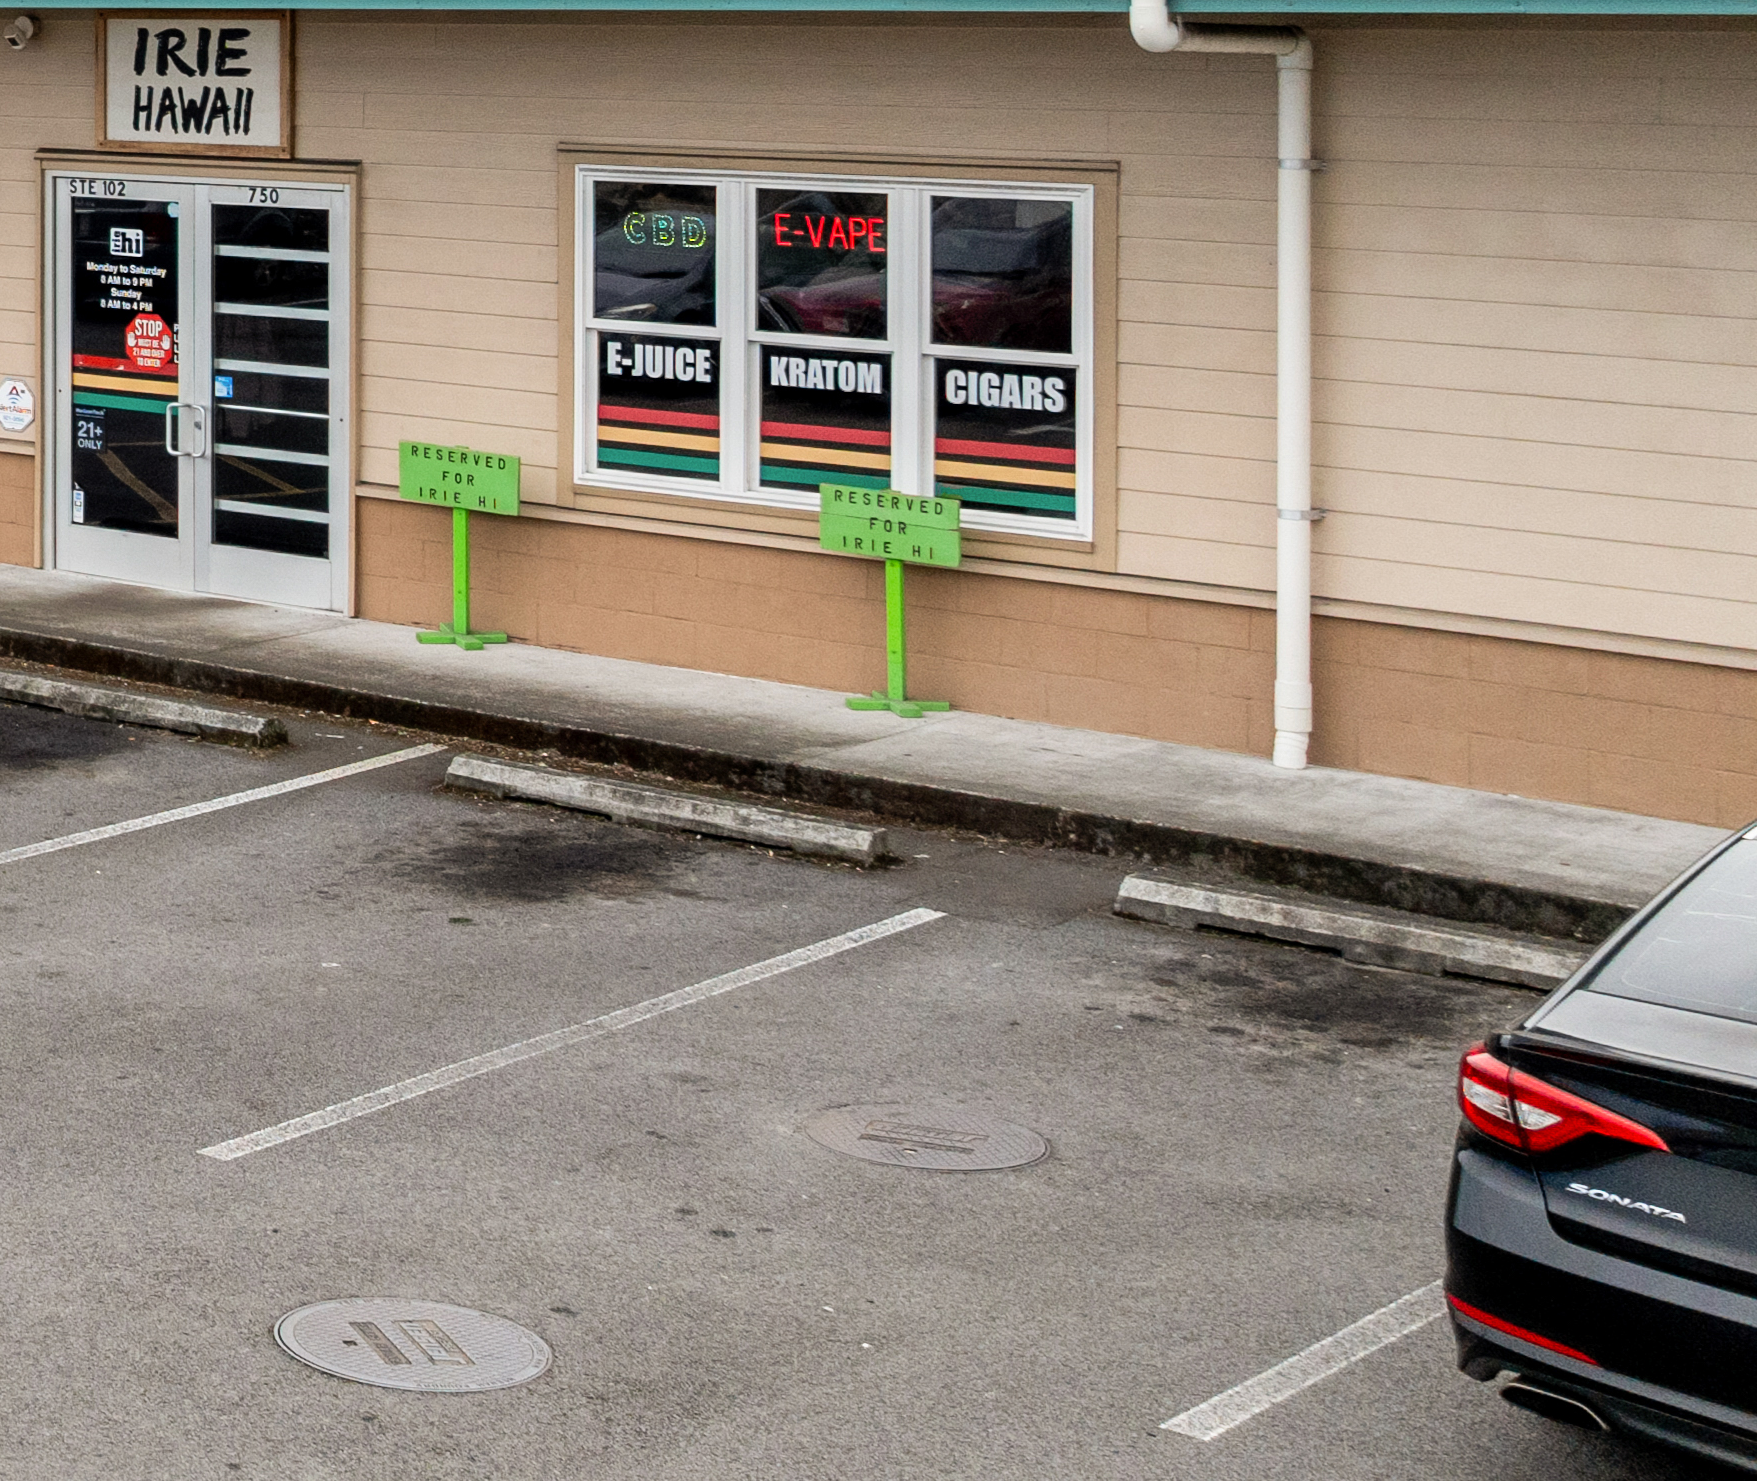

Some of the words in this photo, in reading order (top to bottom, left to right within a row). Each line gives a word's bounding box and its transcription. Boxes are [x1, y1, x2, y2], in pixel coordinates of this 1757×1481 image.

[133, 27, 252, 78] IRIE
[132, 84, 254, 136] HAWAII
[69, 179, 96, 195] STE
[103, 180, 126, 197] 102
[248, 187, 279, 204] 750
[623, 211, 708, 248] CBD
[774, 212, 886, 252] E-VAPE
[121, 231, 141, 255] hi
[86, 261, 118, 275] Monday
[119, 264, 129, 273] to
[129, 264, 167, 279] Saturday
[107, 275, 121, 285] AM
[122, 276, 131, 286] to
[139, 277, 154, 288] PM
[110, 286, 143, 301] Sunday
[107, 299, 121, 309] AM
[122, 301, 131, 310] to
[132, 301, 138, 310] 4
[139, 301, 154, 312] PM
[135, 318, 163, 338] STOP
[133, 347, 140, 356] 21
[152, 339, 160, 348] BE
[137, 357, 144, 366] TO
[606, 341, 712, 383] E-JUICE
[769, 355, 883, 395] KRATOM
[945, 368, 1066, 413] CIGARS
[77, 420, 103, 438] 21+
[77, 438, 103, 450] ONLY
[411, 444, 506, 470] RESERVED
[442, 470, 475, 487] FOR
[419, 486, 462, 504] IRIE
[478, 495, 497, 510] HI
[834, 489, 943, 515] RESERVED
[869, 517, 907, 535] FOR
[842, 535, 892, 554] IRIE
[912, 544, 933, 560] HI
[1565, 1182, 1686, 1224] SONATA
